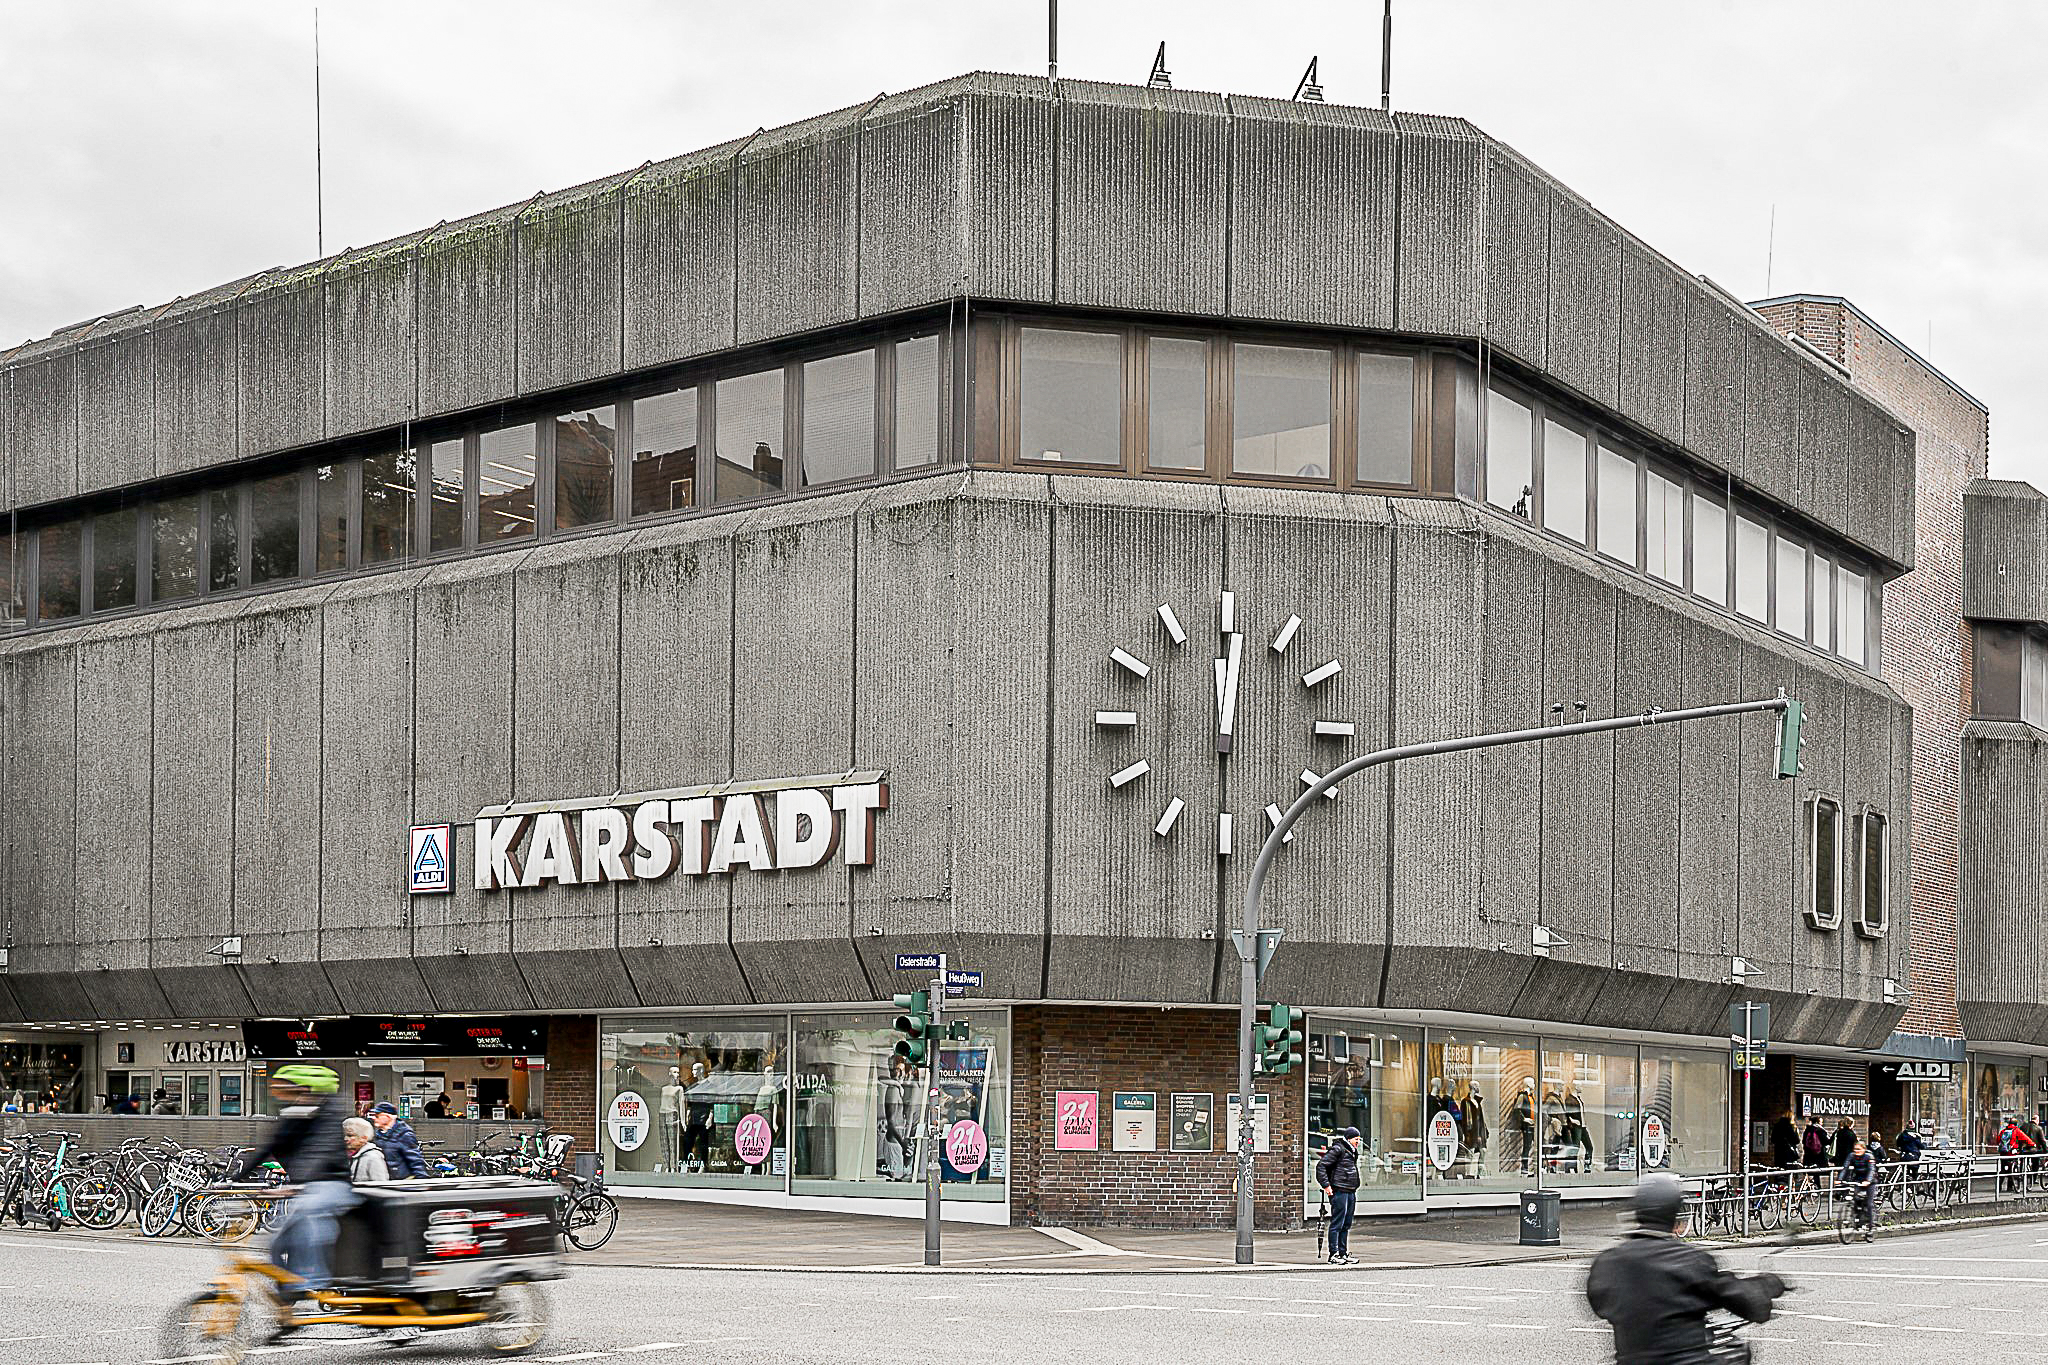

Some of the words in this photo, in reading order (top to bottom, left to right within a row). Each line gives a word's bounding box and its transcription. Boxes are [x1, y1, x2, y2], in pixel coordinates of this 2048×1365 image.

[474, 783, 887, 890] KARSTADT
[417, 871, 442, 883] ALDI
[899, 956, 937, 967] Osterstraße
[949, 973, 980, 987] Heußweg
[163, 1041, 247, 1062] KARSTAD
[22, 1055, 56, 1068] Ikonen
[1897, 1063, 1949, 1077] ALDI
[1060, 1100, 1090, 1121] 21
[1812, 1098, 1840, 1115] MO-SA
[1840, 1099, 1856, 1115] 8-21
[1857, 1100, 1871, 1116] Uhr
[739, 1120, 763, 1141] 21
[951, 1125, 976, 1151] 21
